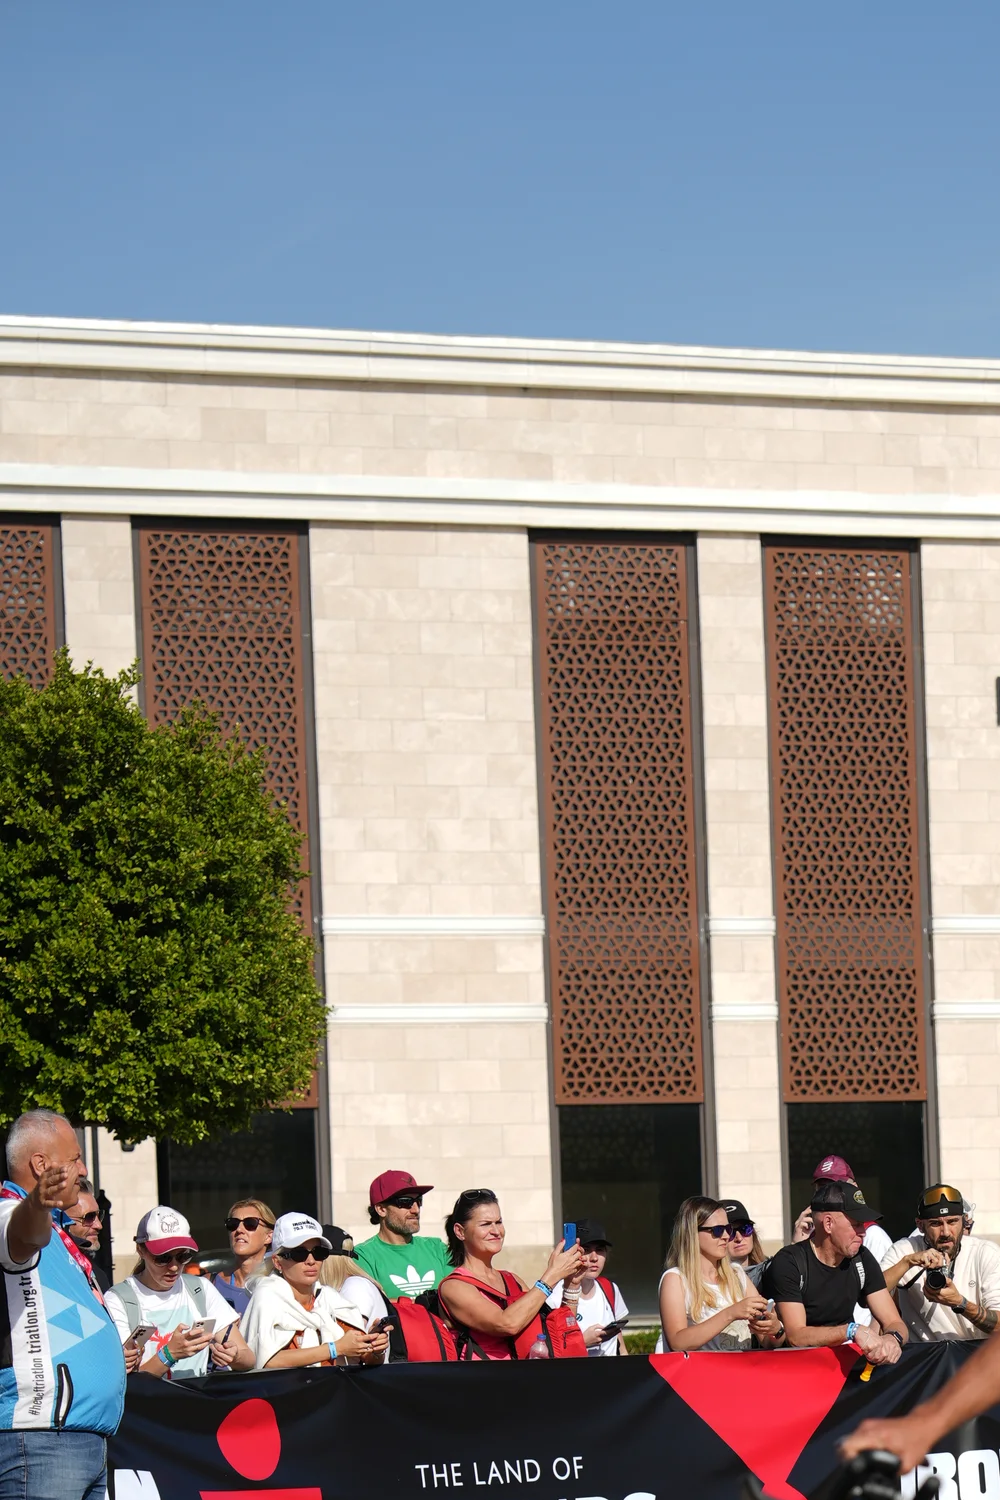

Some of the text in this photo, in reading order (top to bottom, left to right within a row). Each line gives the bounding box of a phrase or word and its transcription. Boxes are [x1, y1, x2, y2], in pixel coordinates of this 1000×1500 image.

[19, 1275, 42, 1354] triatlon.org.tr
[415, 1456, 584, 1488] THE LAND OF
